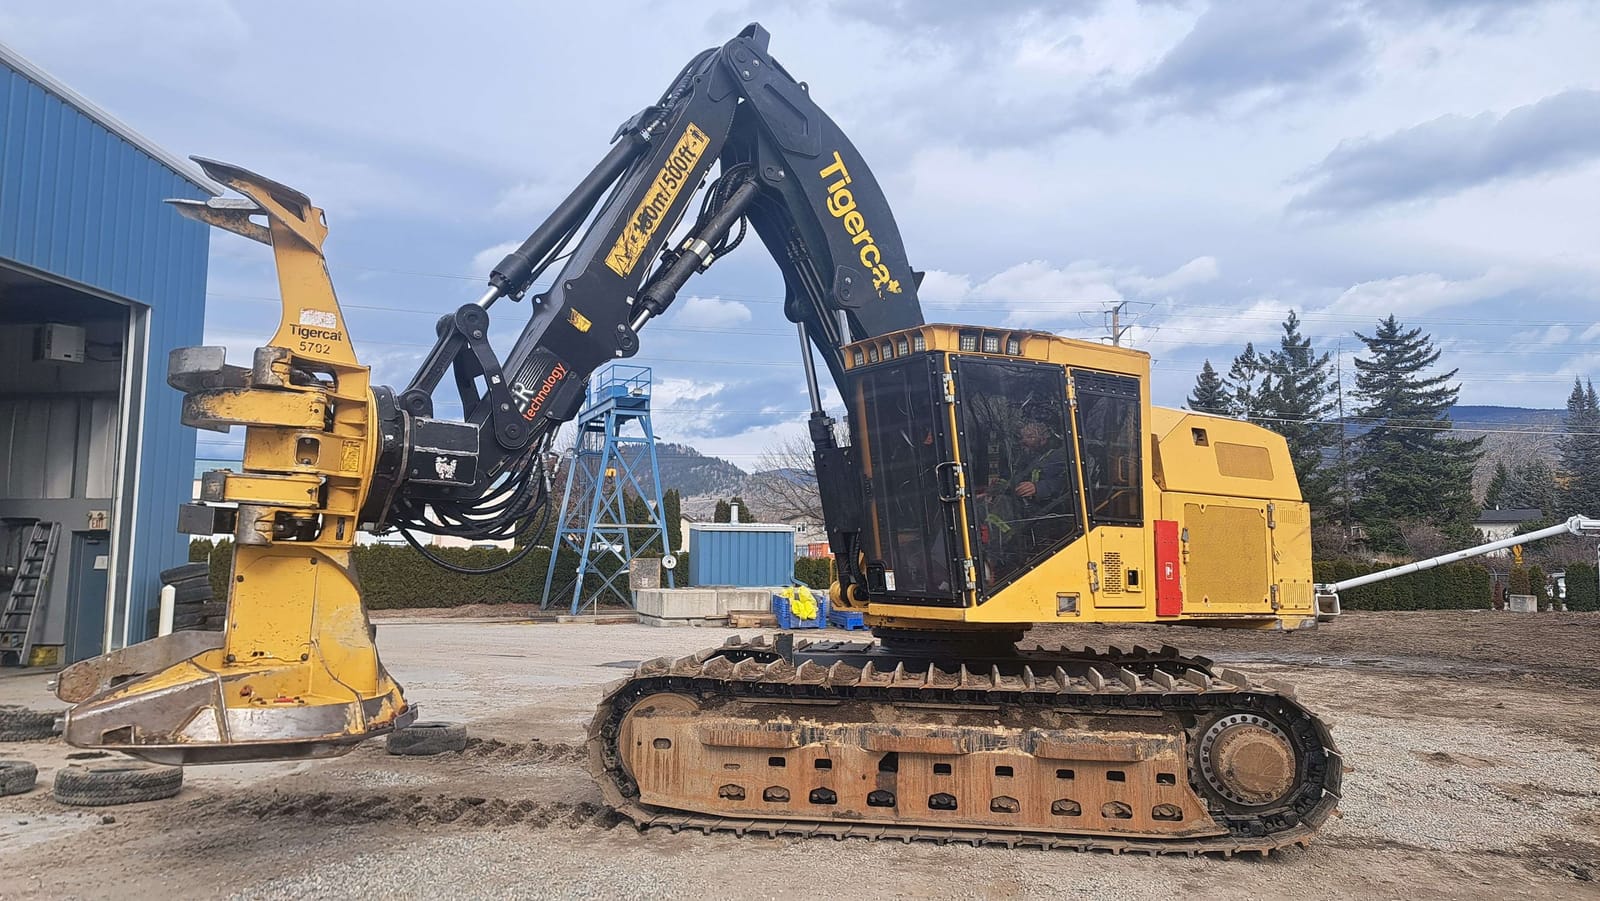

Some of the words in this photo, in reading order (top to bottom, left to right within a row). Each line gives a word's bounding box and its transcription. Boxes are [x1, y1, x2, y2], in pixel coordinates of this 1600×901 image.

[819, 151, 902, 299] Tigercat
[289, 323, 343, 341] Tigercat
[522, 362, 568, 421] technology
